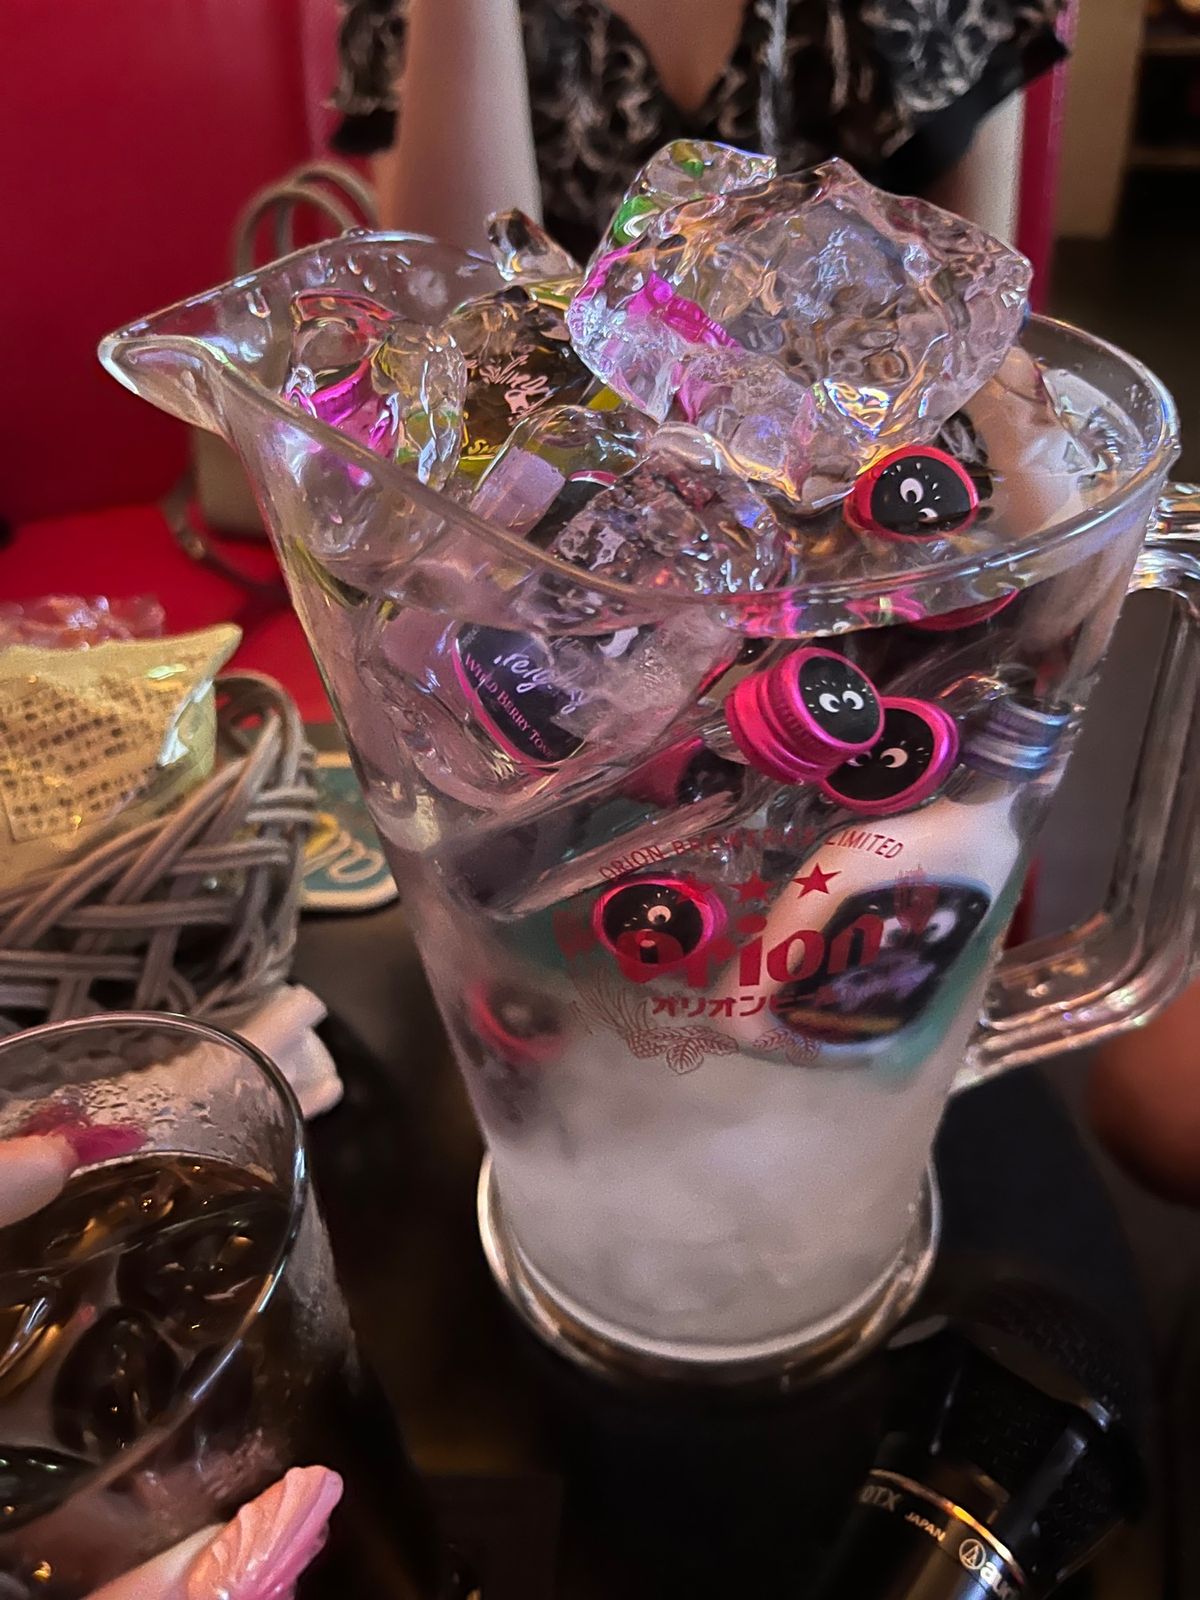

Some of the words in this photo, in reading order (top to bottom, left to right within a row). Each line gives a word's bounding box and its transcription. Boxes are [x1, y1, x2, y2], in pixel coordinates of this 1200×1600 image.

[598, 844, 665, 881] ORION
[824, 829, 904, 859] LIMITED
[904, 1511, 946, 1542] JAPAN
